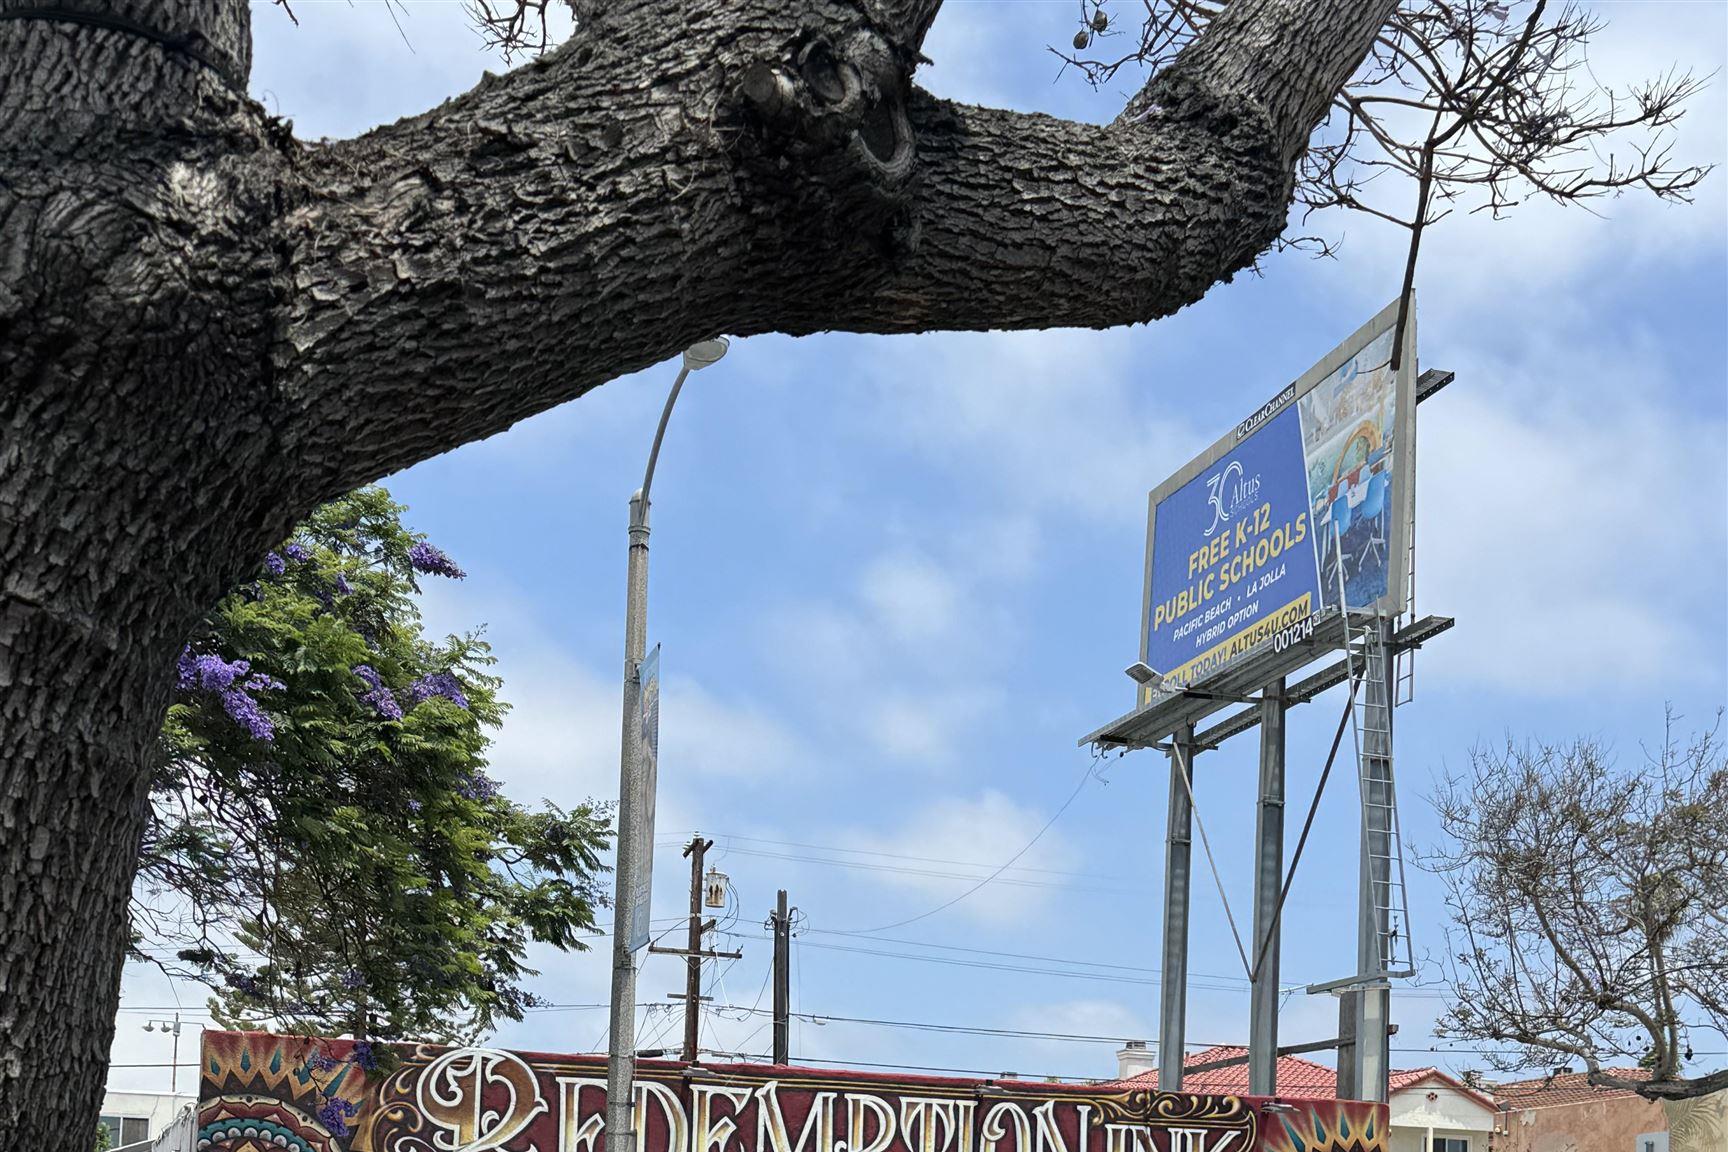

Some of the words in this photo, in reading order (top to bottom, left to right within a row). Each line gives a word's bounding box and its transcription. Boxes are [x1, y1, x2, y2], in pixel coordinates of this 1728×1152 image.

[1230, 474, 1261, 508] Altus
[1154, 572, 1215, 632] PUBLIC
[1219, 512, 1307, 591] SCHOOLS
[1189, 529, 1230, 580] FREE
[1235, 502, 1271, 549] K-12
[1173, 614, 1204, 642] PACIFIC
[1204, 597, 1232, 625] BEACH
[1246, 582, 1257, 599] LA
[1259, 563, 1286, 591] JOLLA
[1190, 646, 1228, 682] TODAY!
[1229, 599, 1308, 660] ALTUS4U.COM
[1195, 620, 1226, 648] HYBRID
[1227, 600, 1259, 629] OPTION
[1274, 616, 1314, 653] 001214
